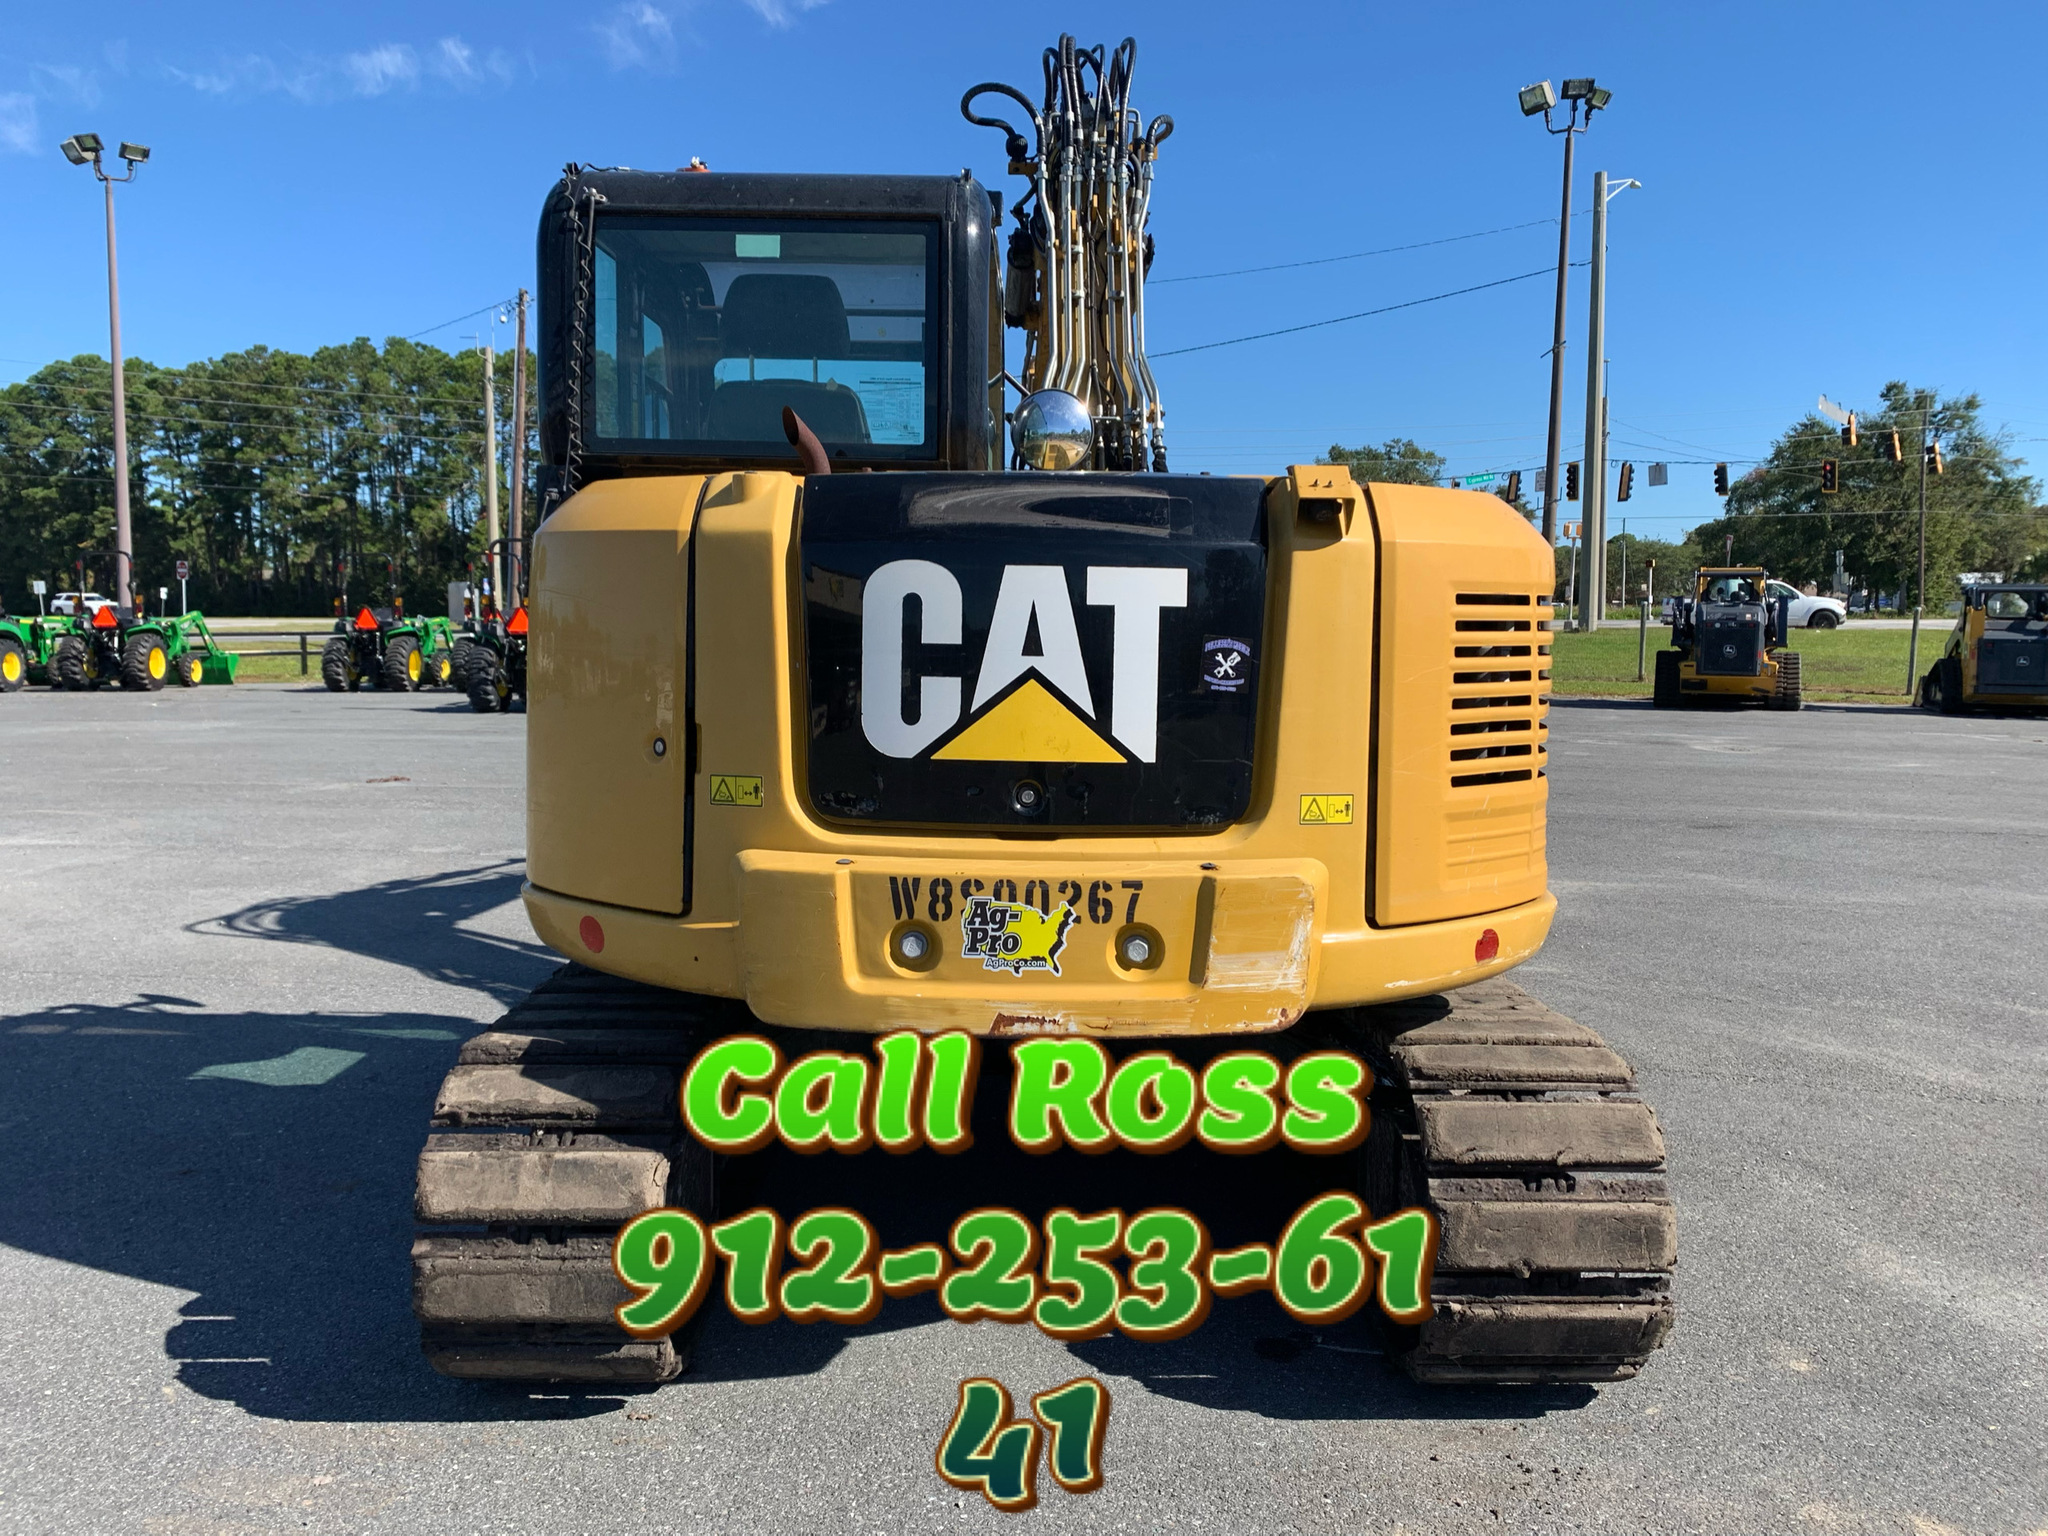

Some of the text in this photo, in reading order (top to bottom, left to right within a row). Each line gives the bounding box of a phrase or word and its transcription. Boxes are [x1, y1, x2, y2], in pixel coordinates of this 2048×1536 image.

[861, 559, 1188, 764] CAT
[967, 900, 1021, 932] Ag-
[966, 927, 1020, 954] Pro
[986, 958, 1046, 968] AgProCo.com
